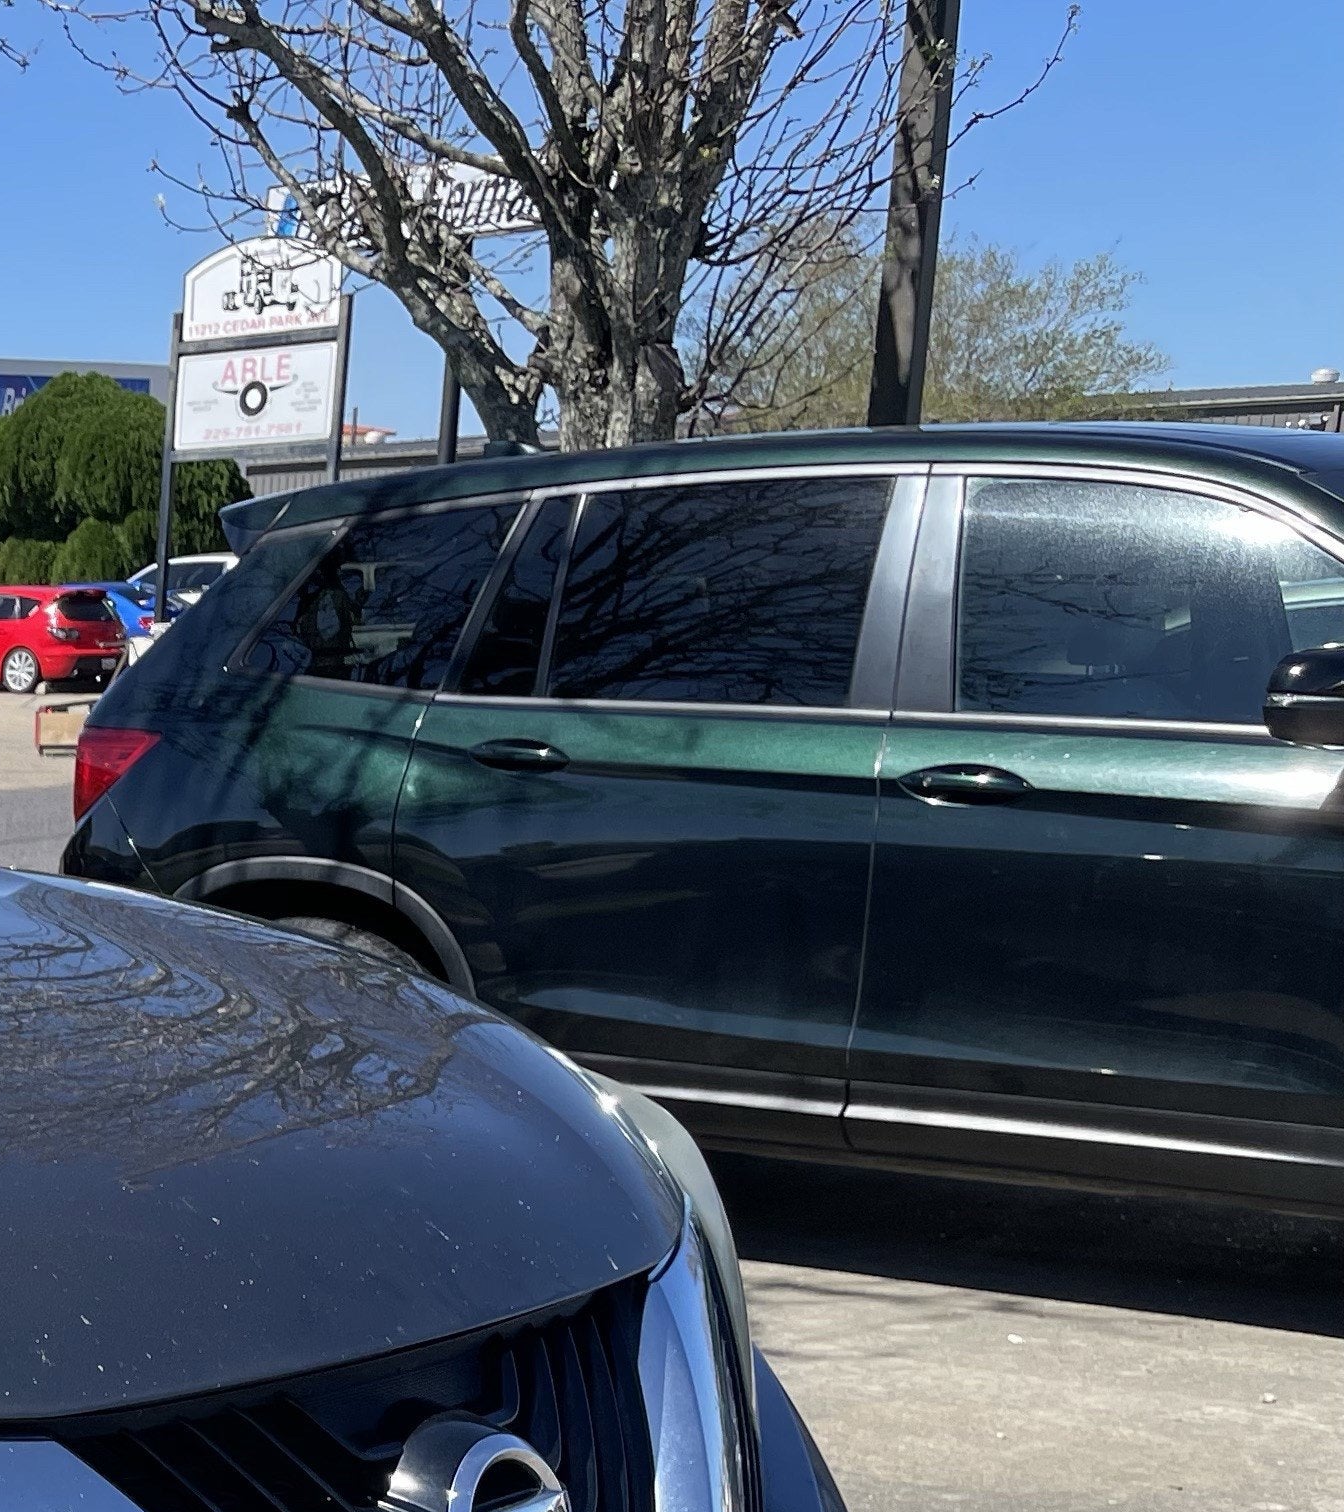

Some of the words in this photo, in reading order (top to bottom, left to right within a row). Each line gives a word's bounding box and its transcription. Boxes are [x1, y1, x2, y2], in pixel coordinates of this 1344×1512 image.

[223, 316, 266, 334] CEDAR
[269, 312, 303, 328] PARK
[220, 353, 292, 386] ABLE
